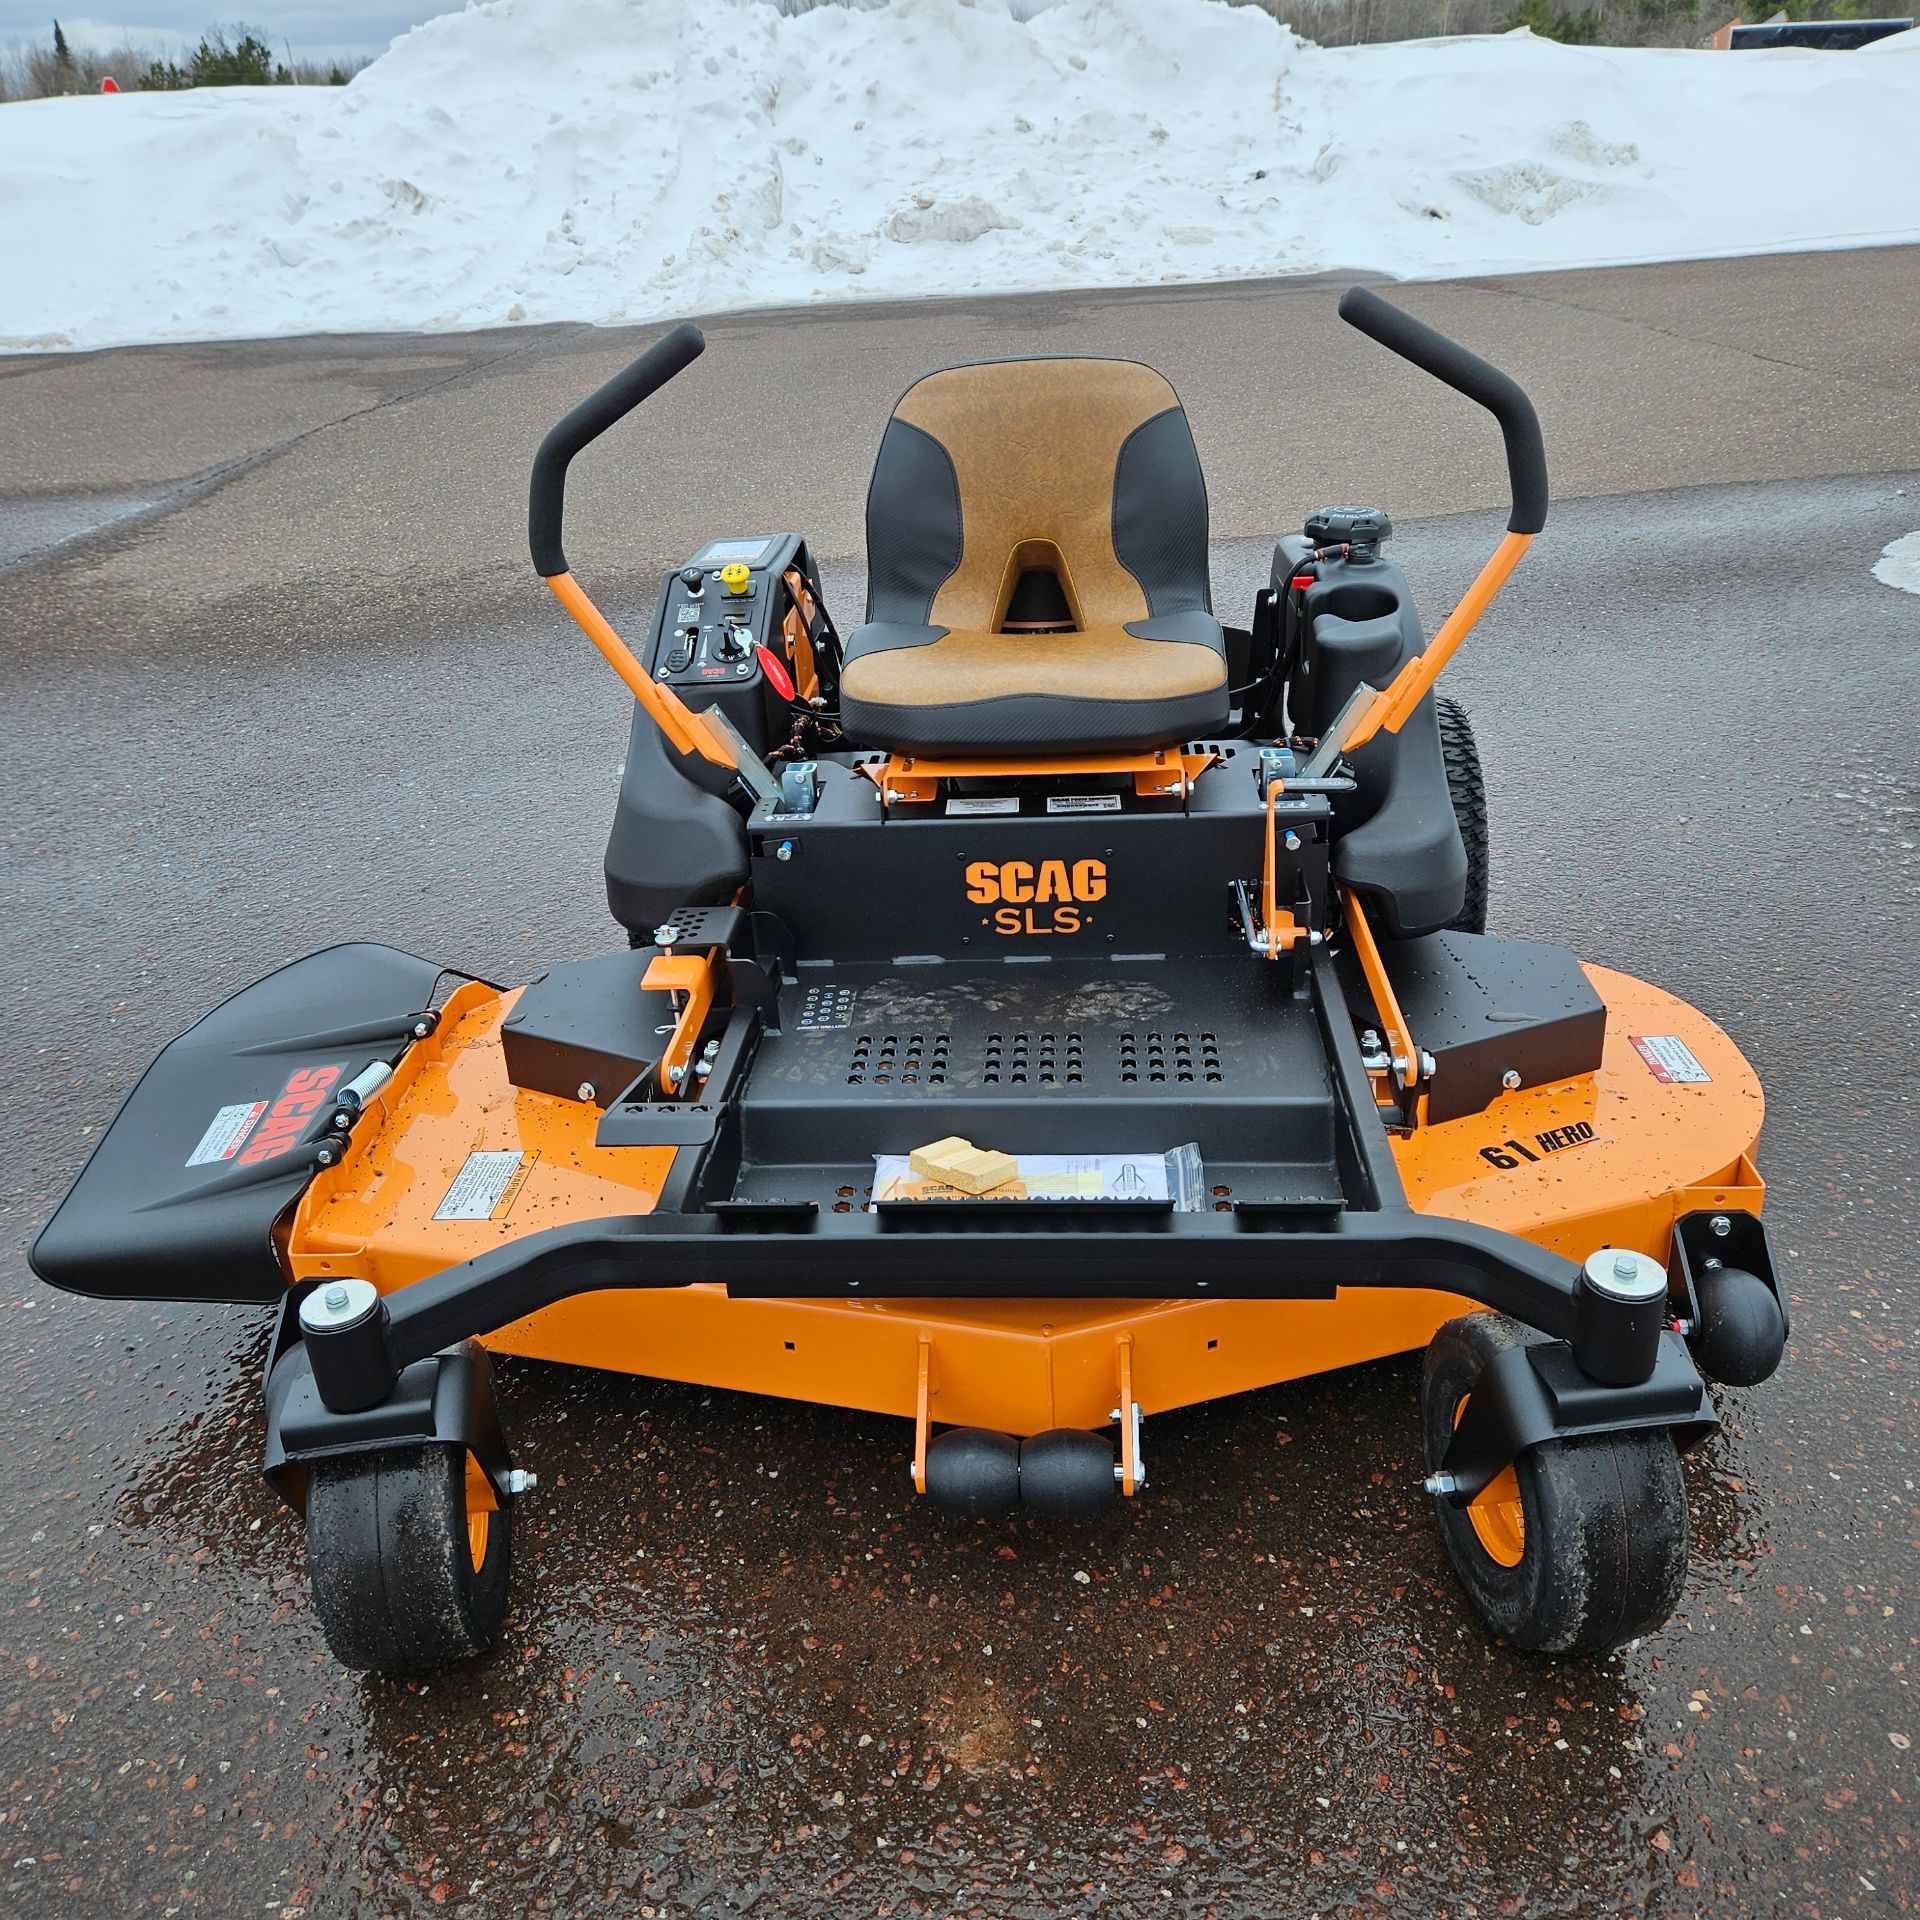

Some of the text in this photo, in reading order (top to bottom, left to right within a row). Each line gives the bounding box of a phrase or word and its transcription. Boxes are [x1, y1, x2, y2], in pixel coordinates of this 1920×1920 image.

[966, 859, 1107, 904] SCAG
[994, 907, 1081, 934] SLS
[1637, 1044, 1660, 1065] DANGER
[238, 1065, 341, 1166] SCAG
[231, 1118, 256, 1151] DANGER
[1479, 1121, 1594, 1170] 61 HERO
[500, 1171, 526, 1204] WARNING
